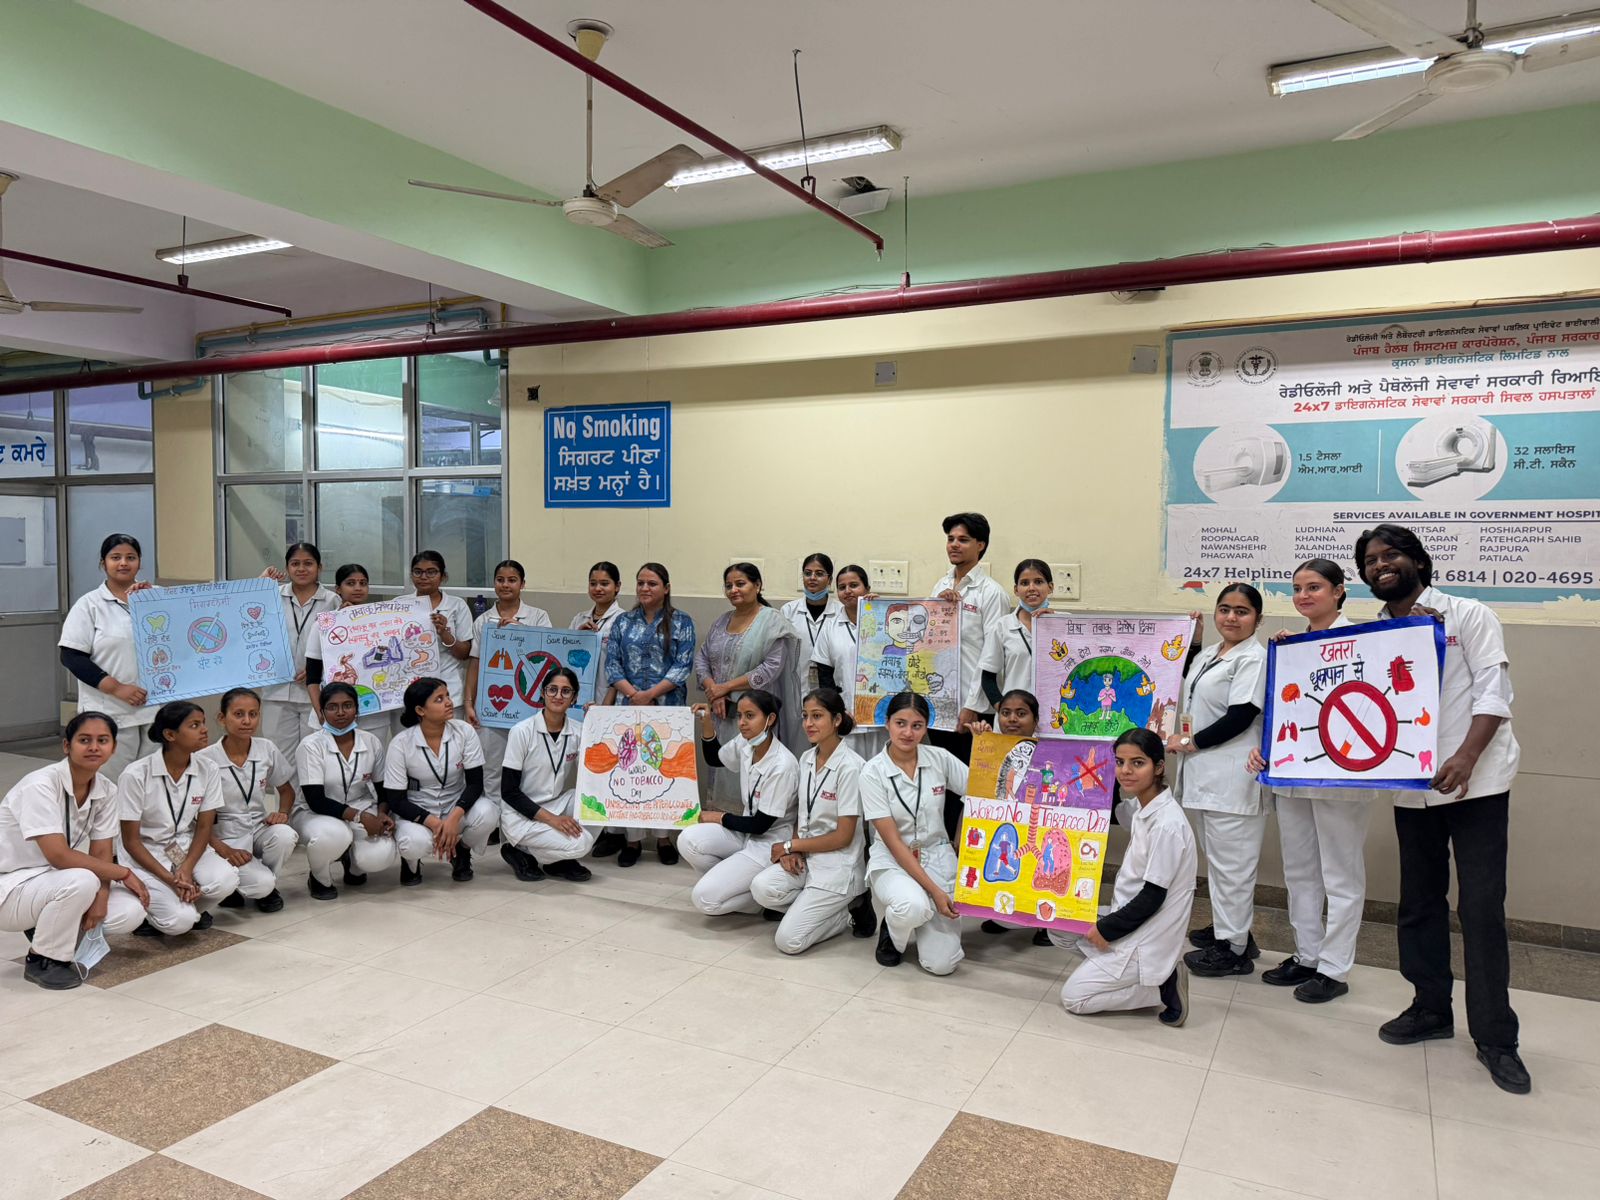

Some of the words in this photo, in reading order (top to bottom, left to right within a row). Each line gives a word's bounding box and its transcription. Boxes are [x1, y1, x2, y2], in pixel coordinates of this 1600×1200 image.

[1353, 344, 1380, 356] ਪੰਜਾਬ
[1526, 332, 1556, 345] ਪੰਜਾਬ
[1547, 348, 1569, 358] ਨਾਲ
[1279, 381, 1342, 398] ਰੇਡੀਓਲੋਜੀ
[1348, 380, 1372, 394] ਅਤੇ
[1379, 376, 1430, 393] ਪੈਥੋਲੋਜੀ
[1436, 374, 1480, 390] ਸੇਵਾਵਾਂ
[1487, 370, 1544, 387] ਸਰਕਾਰੀ
[1294, 401, 1329, 413] 24x7
[1335, 397, 1407, 411] ਡਾਇਗਨੋਸਟਿਕ
[1412, 394, 1446, 408] ਸੇਵਾਵਾਂ
[1451, 391, 1495, 405] ਸਰਕਾਰੀ
[1500, 391, 1533, 403] ਸਿਵਲ
[1539, 387, 1596, 400] ਹਸਪਤਾਲਾਂ
[553, 416, 576, 439] No
[582, 413, 660, 440] Smoking
[11, 436, 47, 462] ਕਮਰੇ
[558, 446, 615, 466] ਸਿਗਰਟ
[622, 444, 660, 464] ਪੀਣਾ
[1514, 446, 1529, 455] 32
[1534, 443, 1576, 454] ਸਲਾਇਸ
[1298, 453, 1312, 461] 1.5
[1316, 450, 1342, 460] ਟੈਸਲਾ
[1550, 457, 1576, 468] ਸਕੈਨ
[1333, 511, 1385, 520] SERVICES
[1388, 511, 1451, 519] AVAILABLE
[1454, 511, 1466, 519] IN
[1470, 511, 1553, 519] GOVERNMENT
[1479, 545, 1529, 553] RAJPURA
[1479, 554, 1523, 562] PATIALA
[1184, 567, 1220, 578] 24x7
[1224, 567, 1293, 581] Helpline
[1445, 570, 1487, 583] 6814
[1502, 571, 1593, 584] 020-4695
[492, 630, 506, 640] Save
[546, 635, 560, 645] Save
[1320, 639, 1357, 662] खतरा
[482, 708, 498, 718] Save
[502, 711, 520, 720] Heart
[613, 778, 625, 786] NO
[631, 776, 663, 786] TOBACCO
